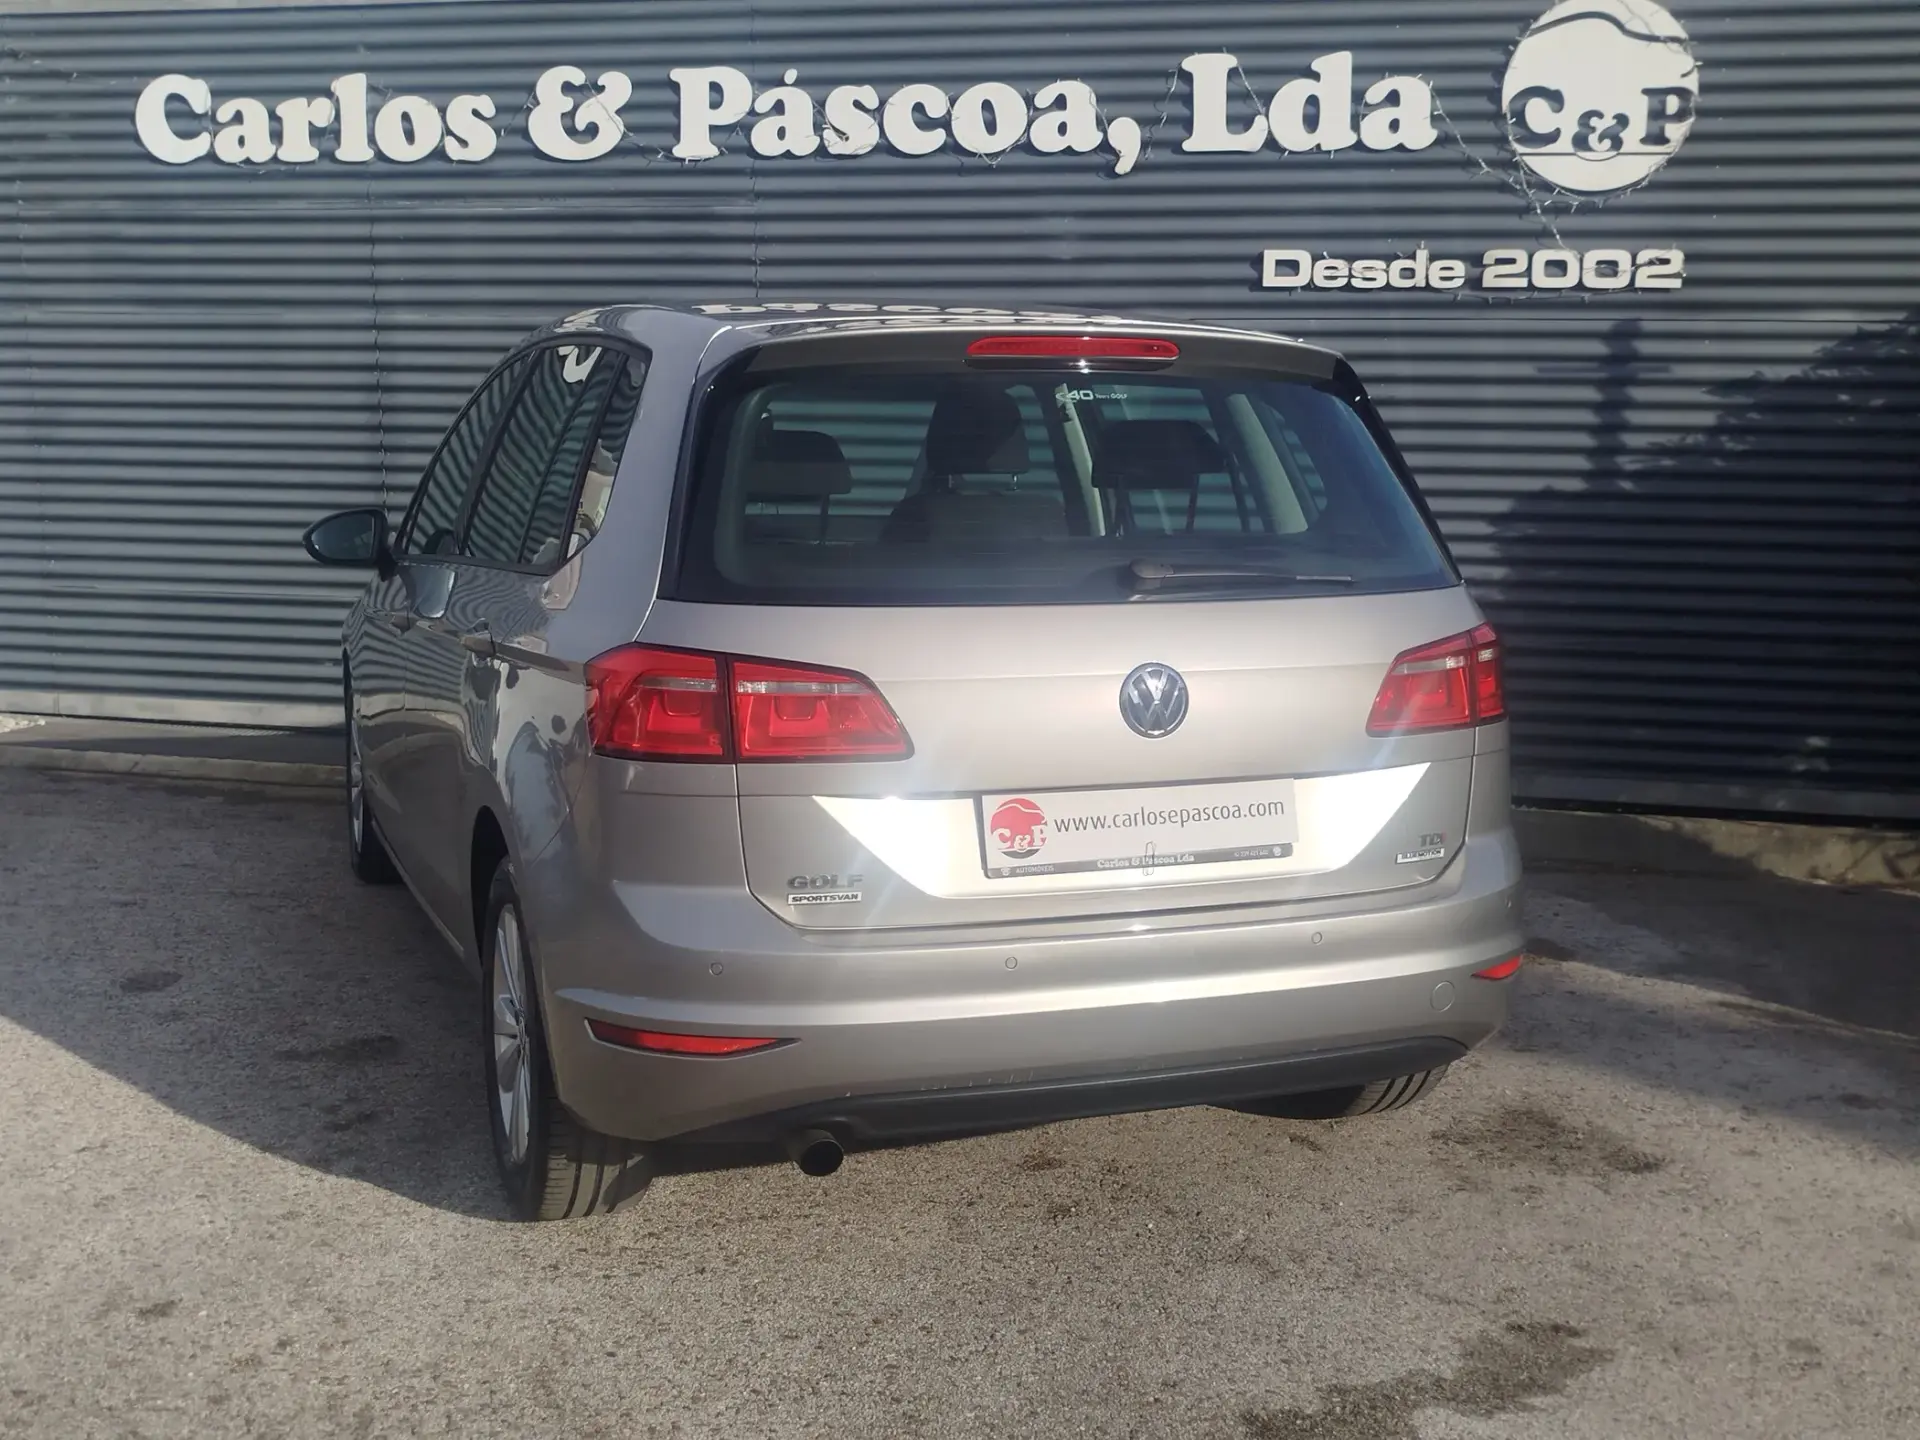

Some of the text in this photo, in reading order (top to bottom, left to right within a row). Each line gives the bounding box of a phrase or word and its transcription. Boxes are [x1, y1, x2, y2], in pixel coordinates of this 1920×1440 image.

[135, 51, 1437, 176] Carlos & Páscoa, Lda
[1262, 249, 1685, 289] Desde 2002
[1053, 799, 1285, 834] www.carlosepascoa.com
[1097, 859, 1129, 868] Carlos
[1177, 853, 1194, 862] Lda
[787, 873, 863, 889] GOLF
[791, 893, 858, 902] SPORTSVAN
